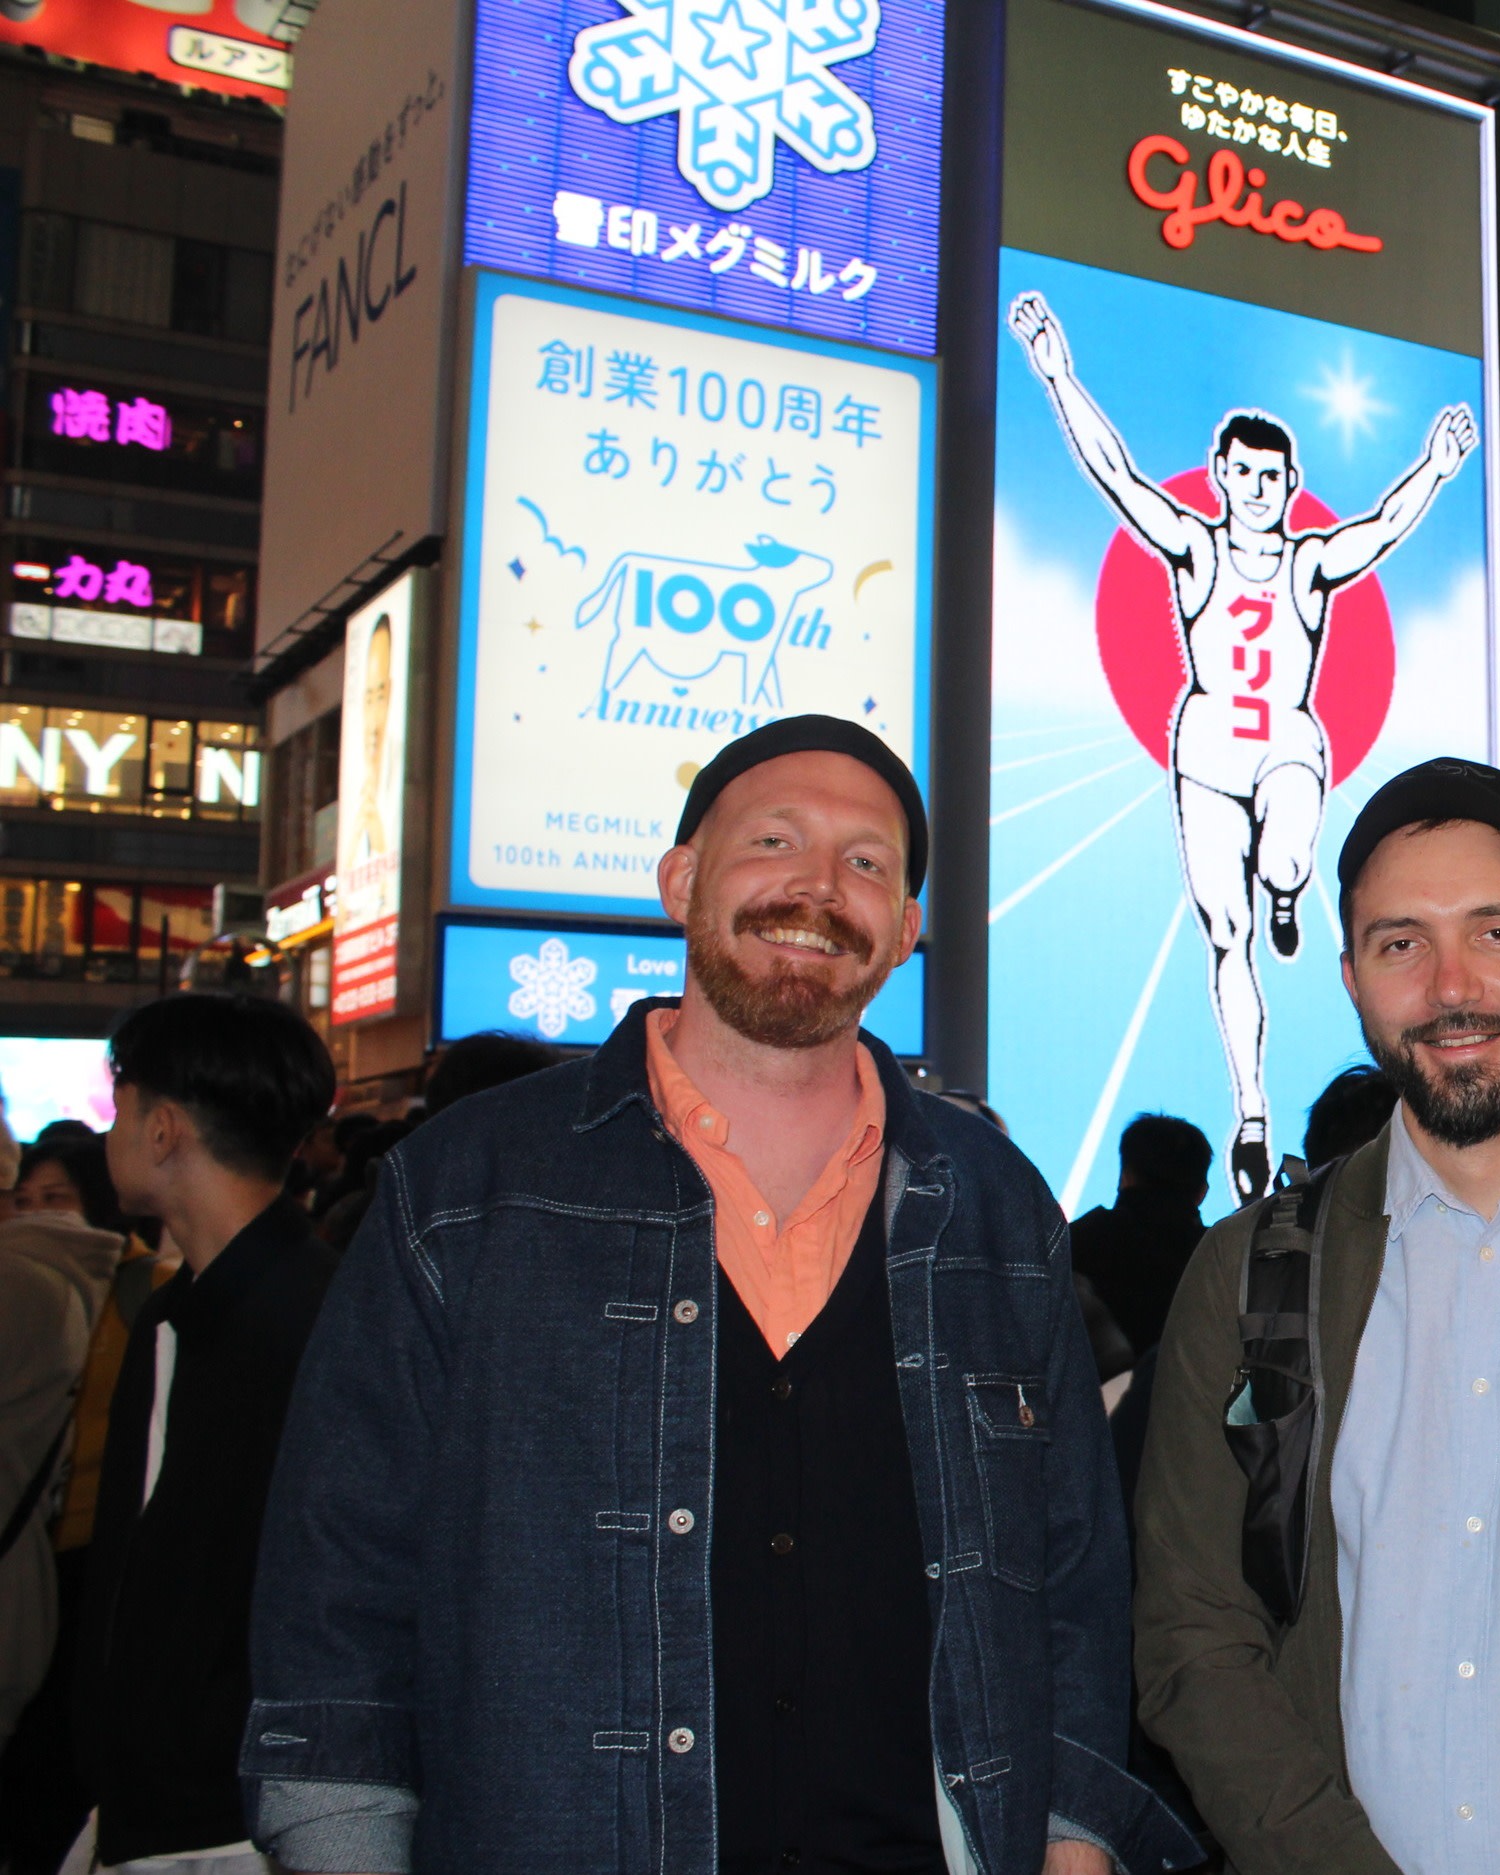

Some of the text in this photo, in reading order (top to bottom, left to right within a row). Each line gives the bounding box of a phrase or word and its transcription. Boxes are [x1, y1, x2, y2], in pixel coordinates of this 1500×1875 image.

[1181, 102, 1332, 168] ゆたかな人生
[1128, 134, 1383, 253] Glico
[552, 191, 878, 301] 雪印メグミルク
[290, 180, 417, 413] FANCL
[536, 339, 883, 448] 創業100周年
[583, 428, 836, 514] ありがとう
[1227, 591, 1276, 741] グリコ
[493, 845, 561, 867] 100th
[545, 812, 664, 839] MEGMILK
[627, 953, 678, 976] Love
